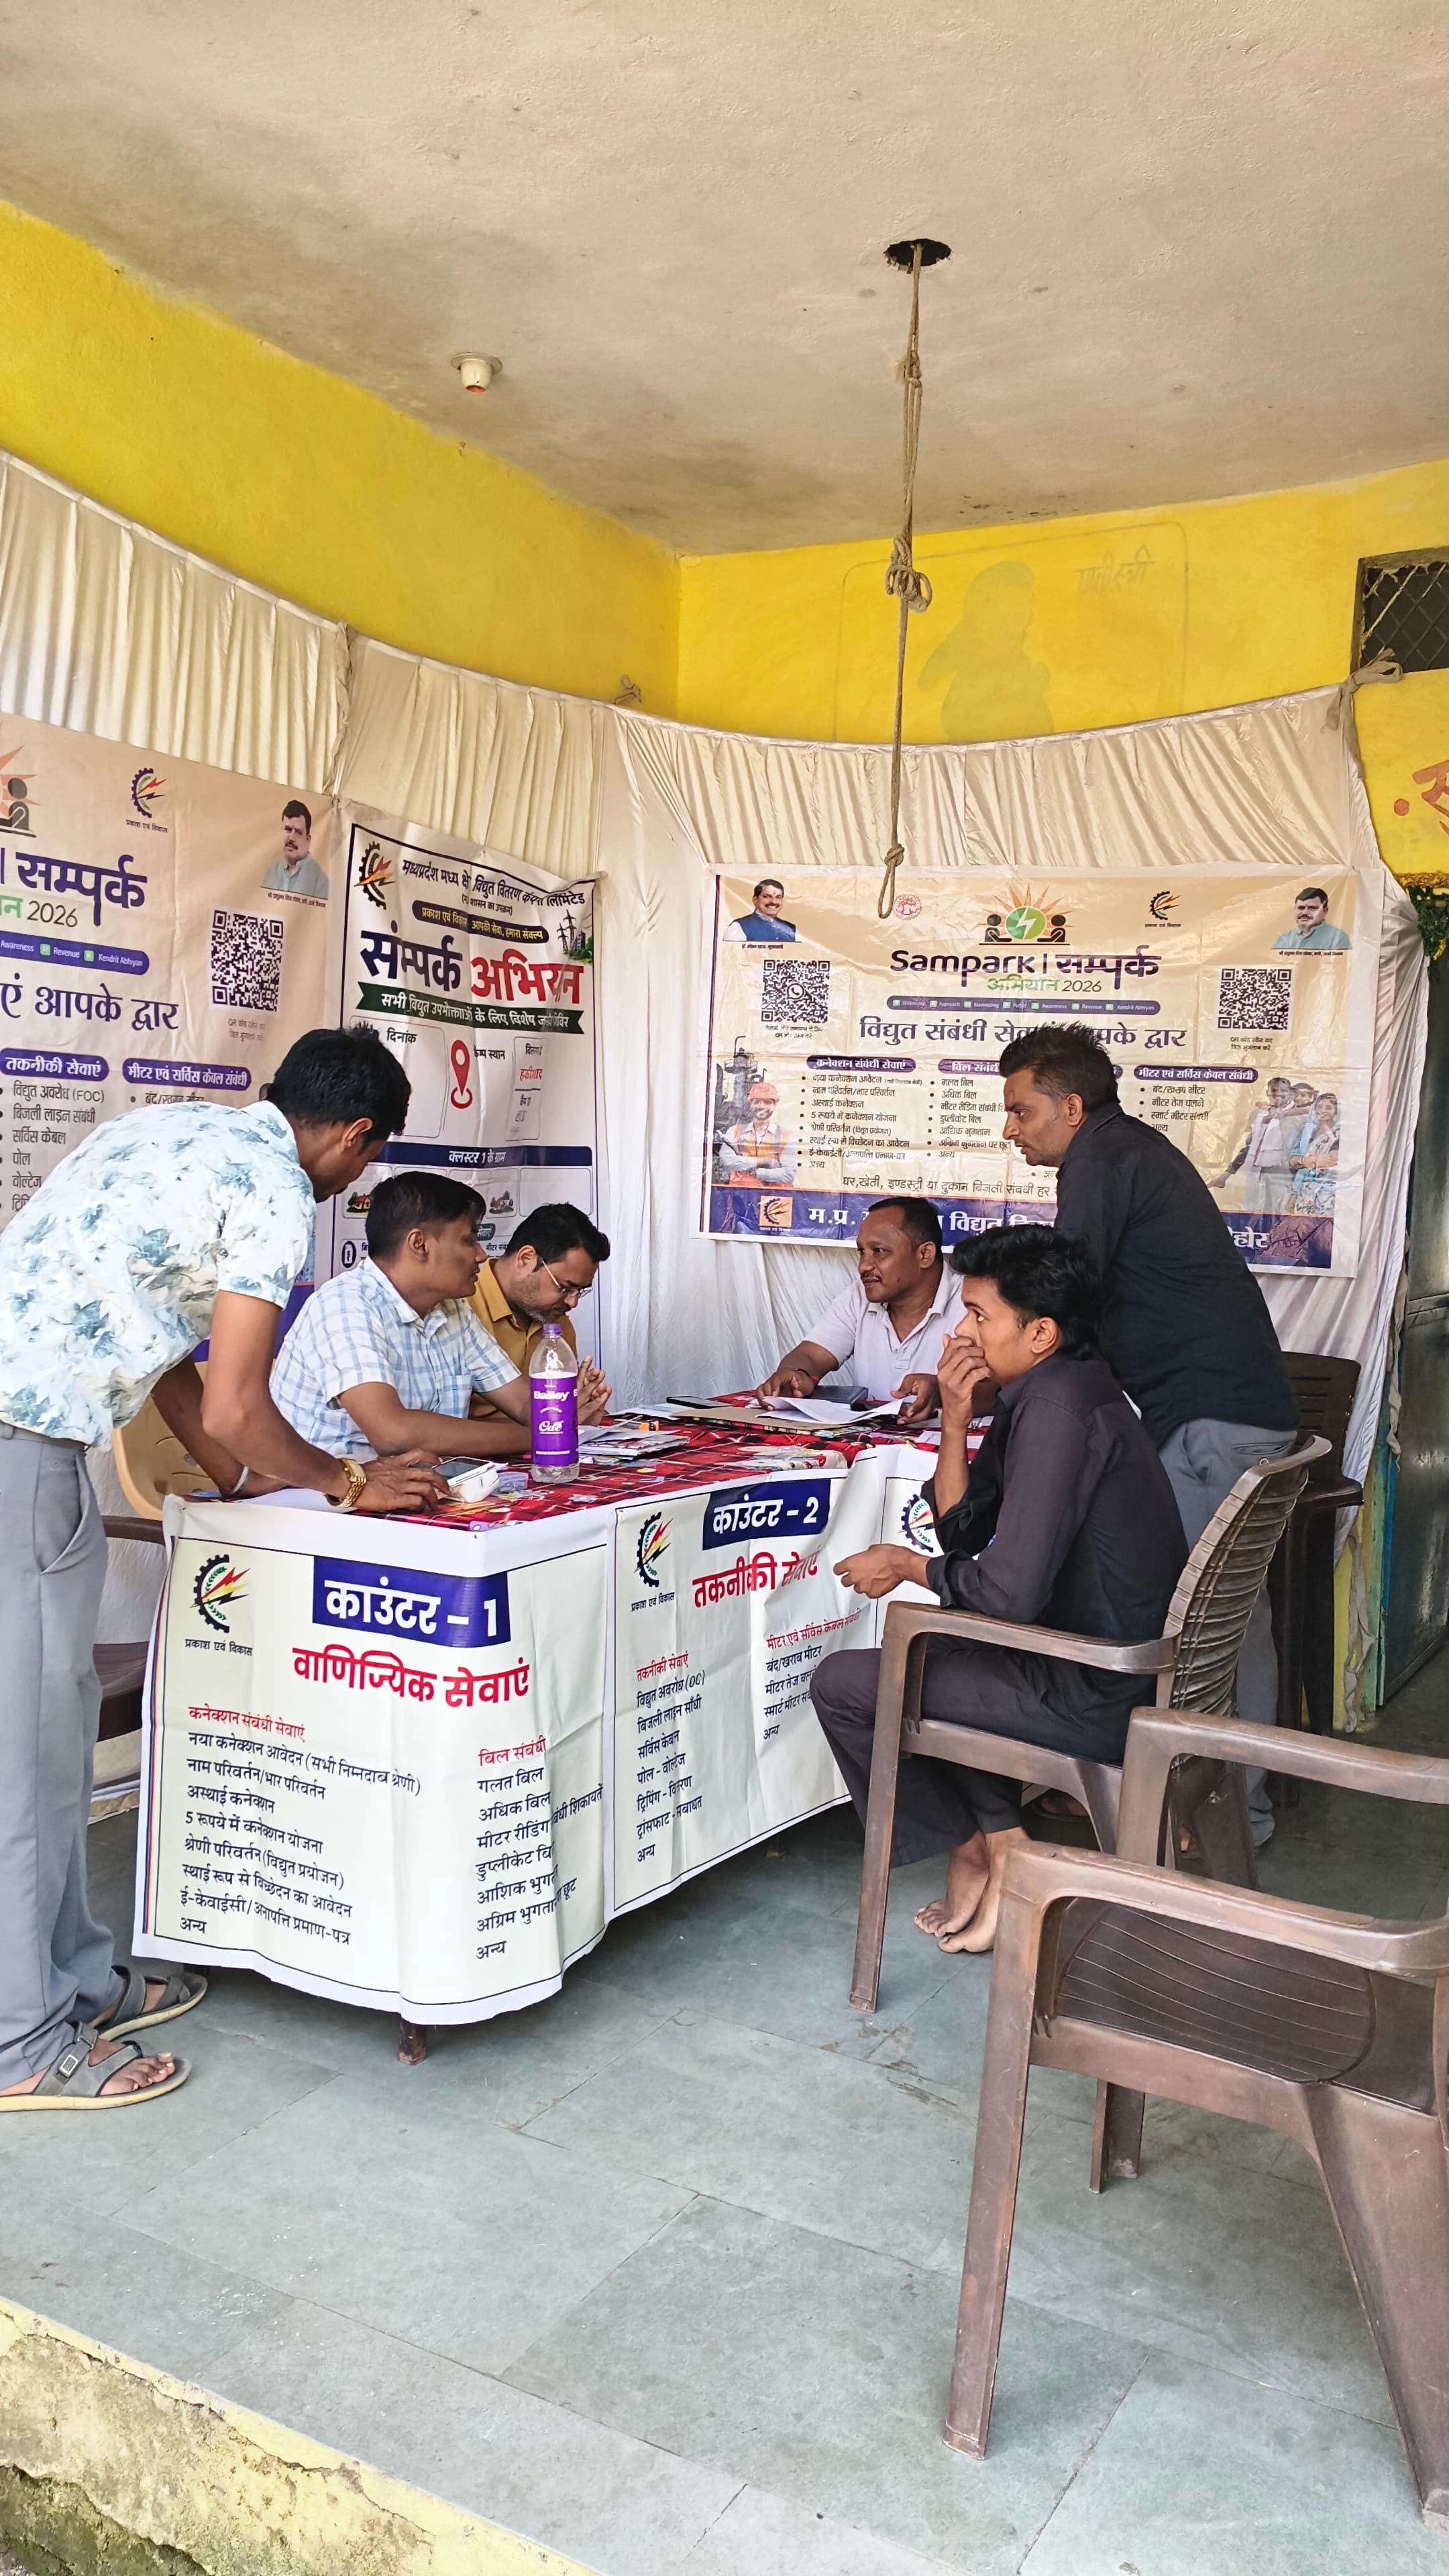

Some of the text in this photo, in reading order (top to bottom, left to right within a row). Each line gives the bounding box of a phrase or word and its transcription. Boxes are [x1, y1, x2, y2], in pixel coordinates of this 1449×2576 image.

[15, 854, 148, 927] सम्पर्क
[402, 859, 524, 902] मध्यप्रदेश मध्य विद्युत वितरण
[27, 900, 78, 928] 2026
[421, 906, 441, 920] प्रकाश
[442, 910, 451, 923] एवं
[472, 920, 491, 933] आपकी
[53, 947, 143, 967] Revenue Kendrit Abhiyan
[1055, 944, 1162, 990] सम्पर्क
[890, 949, 1037, 987] Sampark
[1062, 979, 1102, 994] 2026
[35, 983, 123, 1022] आपके
[131, 999, 179, 1031] द्वार
[381, 991, 407, 1010] सभी
[409, 994, 430, 1017] विद्युत
[474, 1007, 486, 1023] के
[488, 1008, 508, 1025] लिए
[509, 1010, 536, 1026] विशेष
[386, 1027, 418, 1044] दिनांक
[859, 1016, 918, 1046] विद्युत
[924, 1018, 987, 1042] संबंधी
[1144, 1029, 1187, 1049] द्वार
[488, 1049, 506, 1061] स्थान
[816, 1057, 906, 1070] कनेक्शन संबंधी सेवाएं
[5, 1055, 102, 1077] तकनीकी सेवाएं
[127, 1063, 248, 1087] मीटर एवं सर्विस केबल संबंधी
[951, 1062, 971, 1072] बिल
[1138, 1067, 1254, 1081] मीटर एवं सर्विस केबल संबंधी
[812, 1074, 826, 1082] नया
[828, 1073, 857, 1083] कनेक्शन
[859, 1073, 882, 1084] आवेदन
[941, 1077, 973, 1087] गलत बिल
[13, 1079, 105, 1104] विद्युत अवरोध (FOC)
[812, 1086, 896, 1097] नाम परिवर्तन
[941, 1089, 977, 1099] अधिक बिल
[1188, 1084, 1206, 1095] मीटर
[835, 1097, 865, 1109] कनेक्शन
[940, 1101, 957, 1112] मीटर
[978, 1102, 997, 1112] संबंधी
[1151, 1097, 1204, 1108] मीटर तेज चलने
[13, 1103, 96, 1124] बिजली लाइन संबंधी
[810, 1111, 816, 1119] 5
[845, 1111, 874, 1122] कनेक्शन
[875, 1112, 897, 1122] योजना
[968, 1114, 982, 1124] बिल
[1171, 1109, 1189, 1121] मीटर
[12, 1126, 67, 1145] सर्विस केबल
[875, 1139, 910, 1148] का आवेदन
[965, 1128, 991, 1138] भुगतान
[12, 1148, 31, 1166] पोल
[449, 1150, 486, 1164] क्लस्टर 1
[939, 1150, 955, 1159] अन्य
[888, 1177, 1051, 1197] इण्डस्ट्री या दुकान बिजली संबंधी हर
[712, 1493, 819, 1535] काउंटर 2
[692, 1551, 777, 1608] तकनीकी
[324, 1576, 498, 1638] काउंटर 1
[631, 1599, 647, 1613] प्रकाश
[184, 1638, 253, 1657] प्रकाश एवं विकास
[766, 1629, 799, 1650] मीटर एवं
[804, 1644, 823, 1660] मीटर
[292, 1643, 530, 1707] वाणिज्यिक सेवाएं
[636, 1656, 667, 1682] तकनीकी
[764, 1674, 799, 1695] मीटर तेज
[637, 1690, 657, 1709] विद्युत
[188, 1703, 305, 1743] कनेक्शन संबंधी सेवाएं
[637, 1708, 663, 1734] बिजली
[188, 1731, 390, 1785] नया कनेक्शन आवेदन (सभी निम्नदाब
[478, 1734, 547, 1767] बिल संबंधी
[637, 1737, 661, 1760] सर्विस
[186, 1758, 327, 1800] नाम परिवर्तन
[477, 1767, 545, 1793] गलत बिल
[637, 1766, 655, 1784] पोल
[187, 1784, 276, 1814] अस्थाई कनेक्शन
[478, 1790, 552, 1822] अधिक बिल
[185, 1811, 324, 1855] 5 में कनेक्शन योजना
[476, 1819, 551, 1849] मीटर रीडिंग
[184, 1833, 212, 1855] श्रेणी
[637, 1843, 656, 1862] अन्य
[182, 1863, 353, 1919] स्थाई रूप से का आवेदन
[180, 1917, 207, 1935] अन्य
[476, 1911, 517, 1932] अग्रिम
[476, 1940, 507, 1960] अन्य
